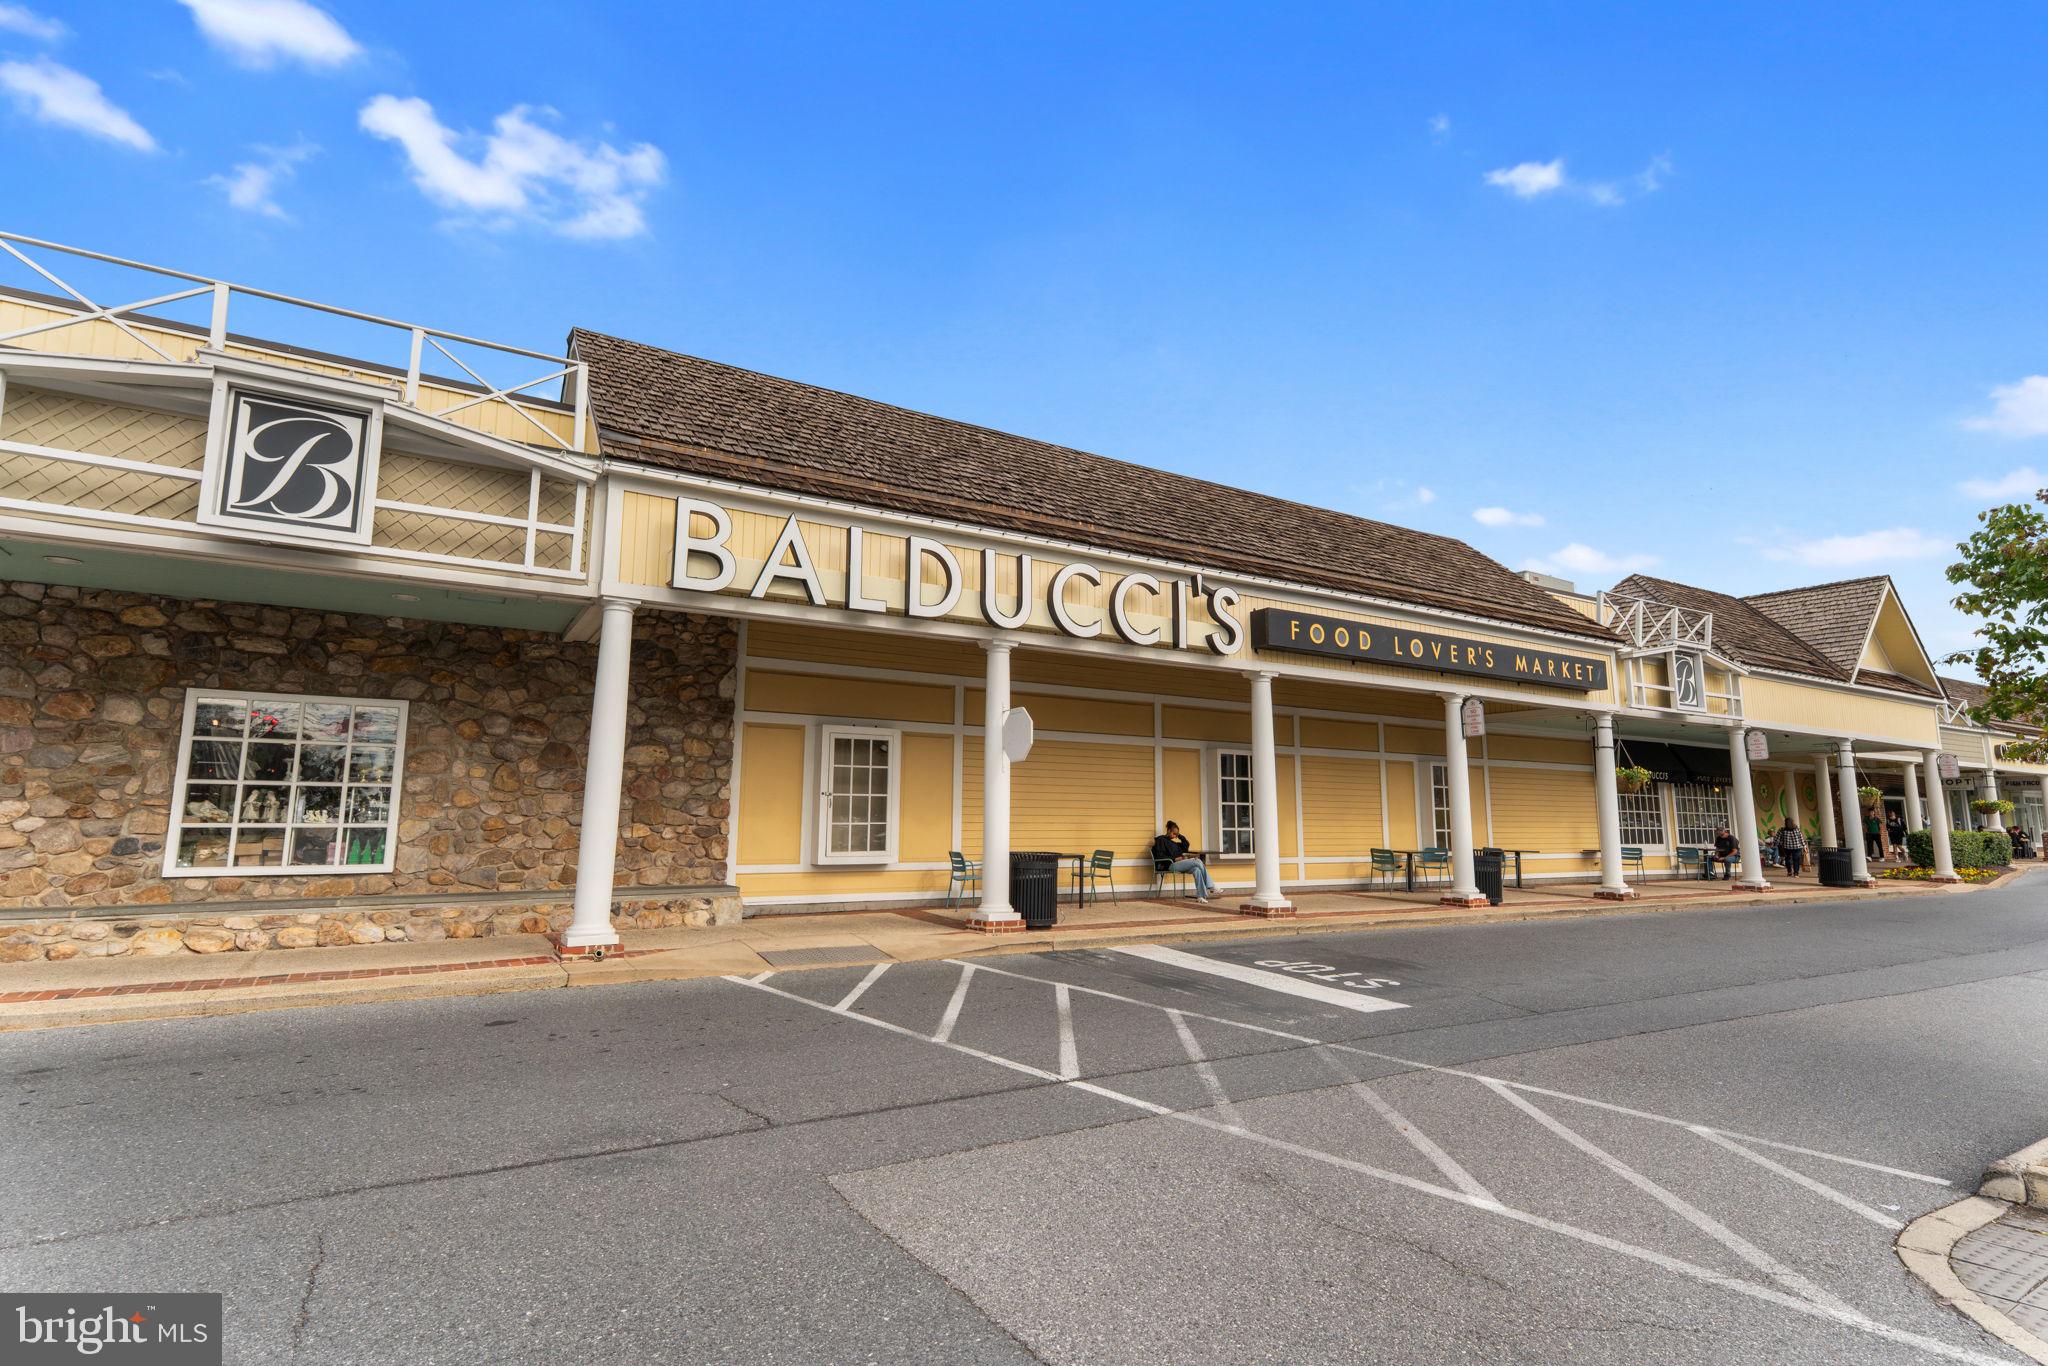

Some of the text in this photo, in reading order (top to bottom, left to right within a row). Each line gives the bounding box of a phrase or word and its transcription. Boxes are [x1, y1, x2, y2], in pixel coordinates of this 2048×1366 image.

[229, 399, 355, 521] B
[671, 496, 1244, 656] BALDUCCI'S
[1290, 620, 1595, 683] FOOD LOVER'S MARKET
[1253, 959, 1401, 989] STOP
